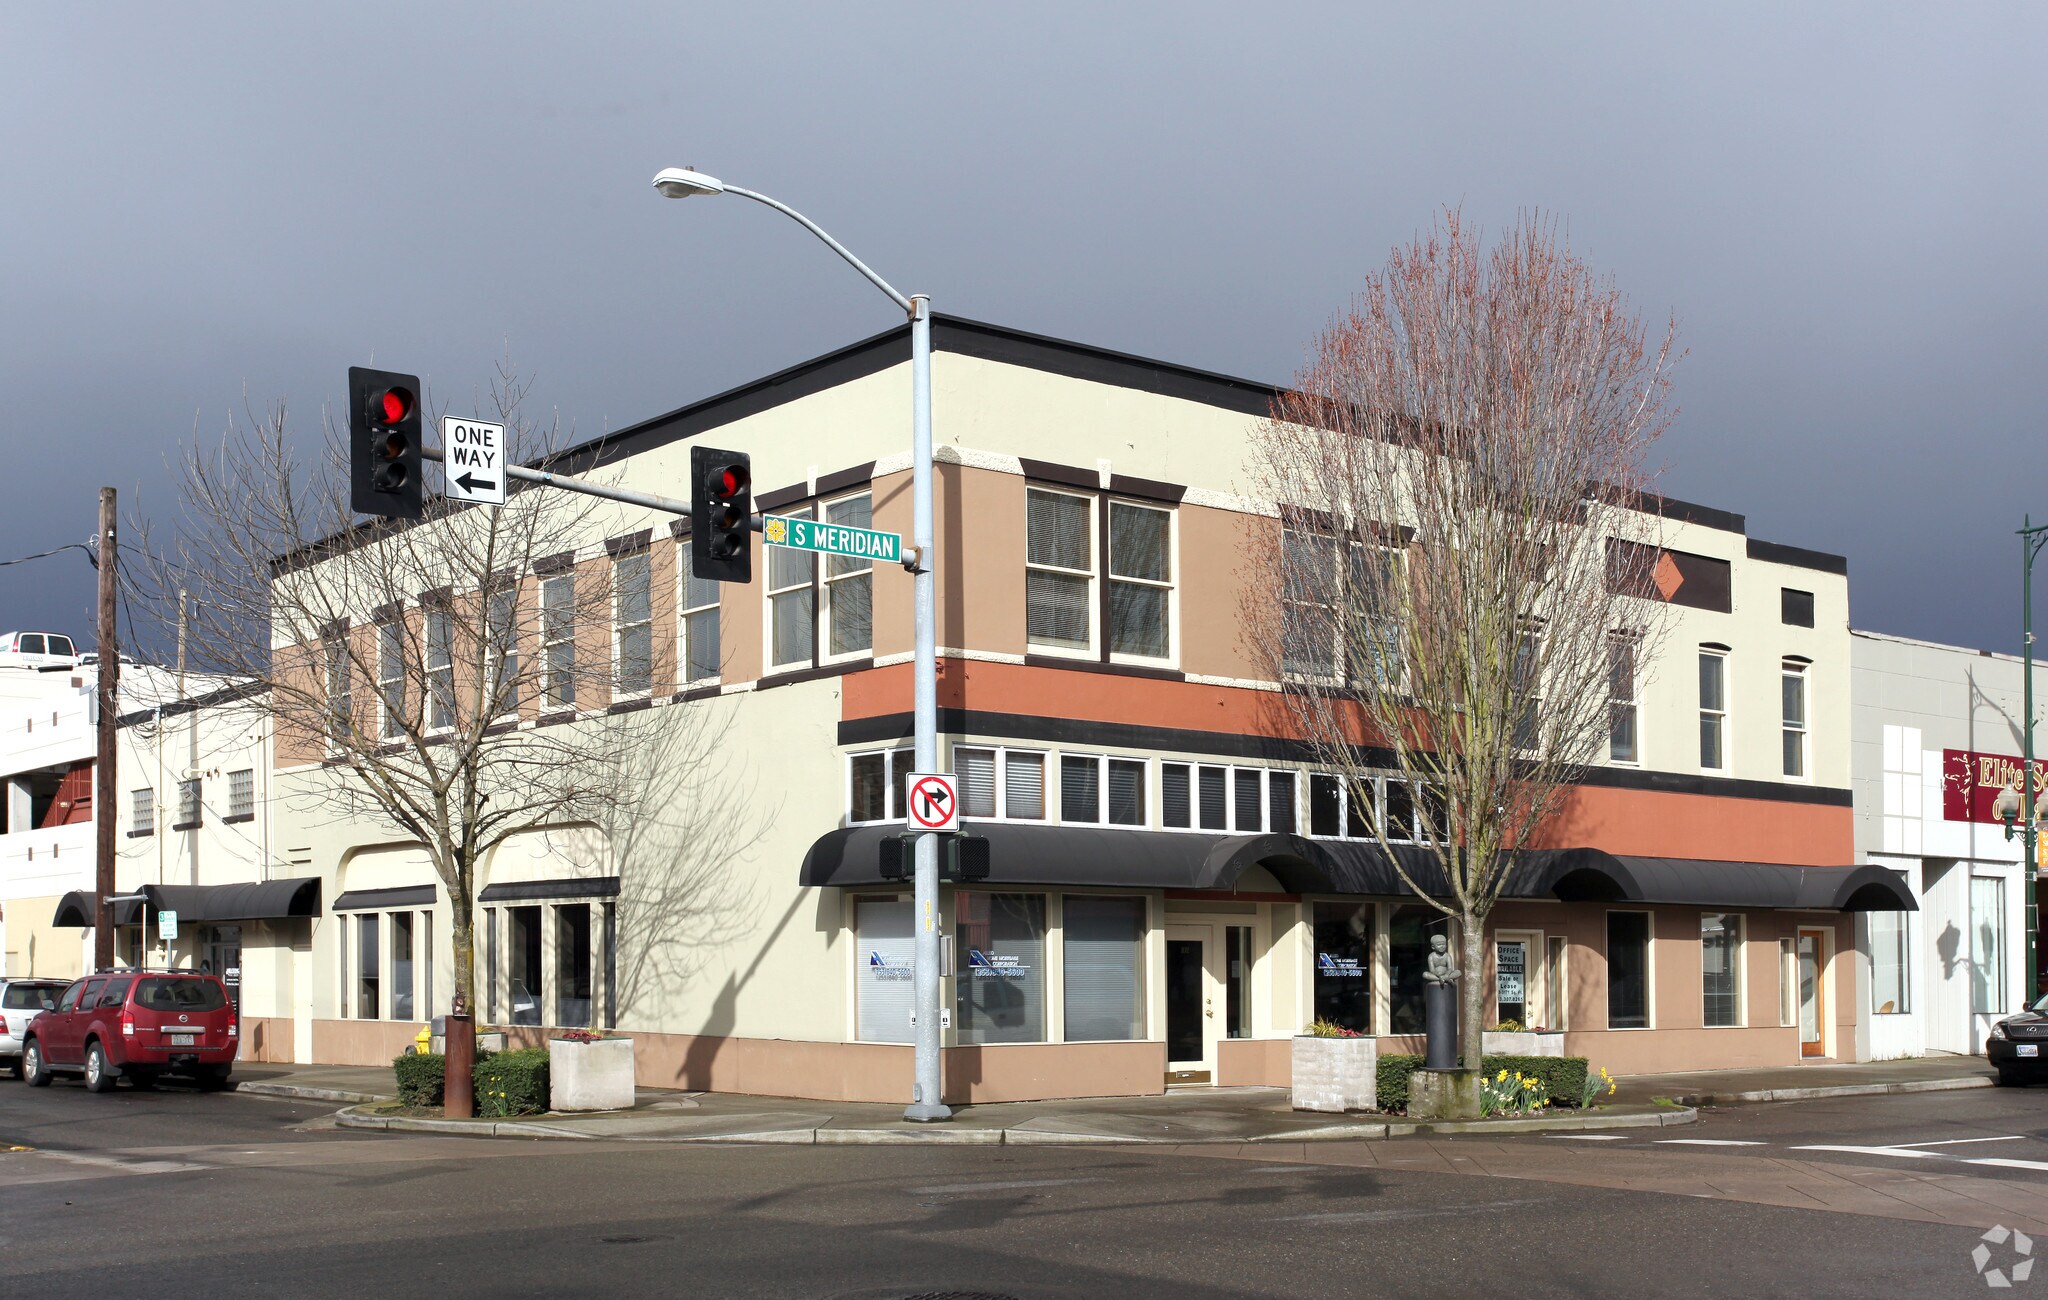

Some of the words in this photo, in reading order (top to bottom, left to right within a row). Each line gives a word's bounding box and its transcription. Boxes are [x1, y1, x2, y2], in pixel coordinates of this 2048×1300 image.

[455, 425, 494, 447] ONE
[453, 446, 495, 469] WAY
[795, 523, 805, 546] S
[814, 525, 893, 558] MERIDIAN
[1978, 756, 2024, 790] Elite
